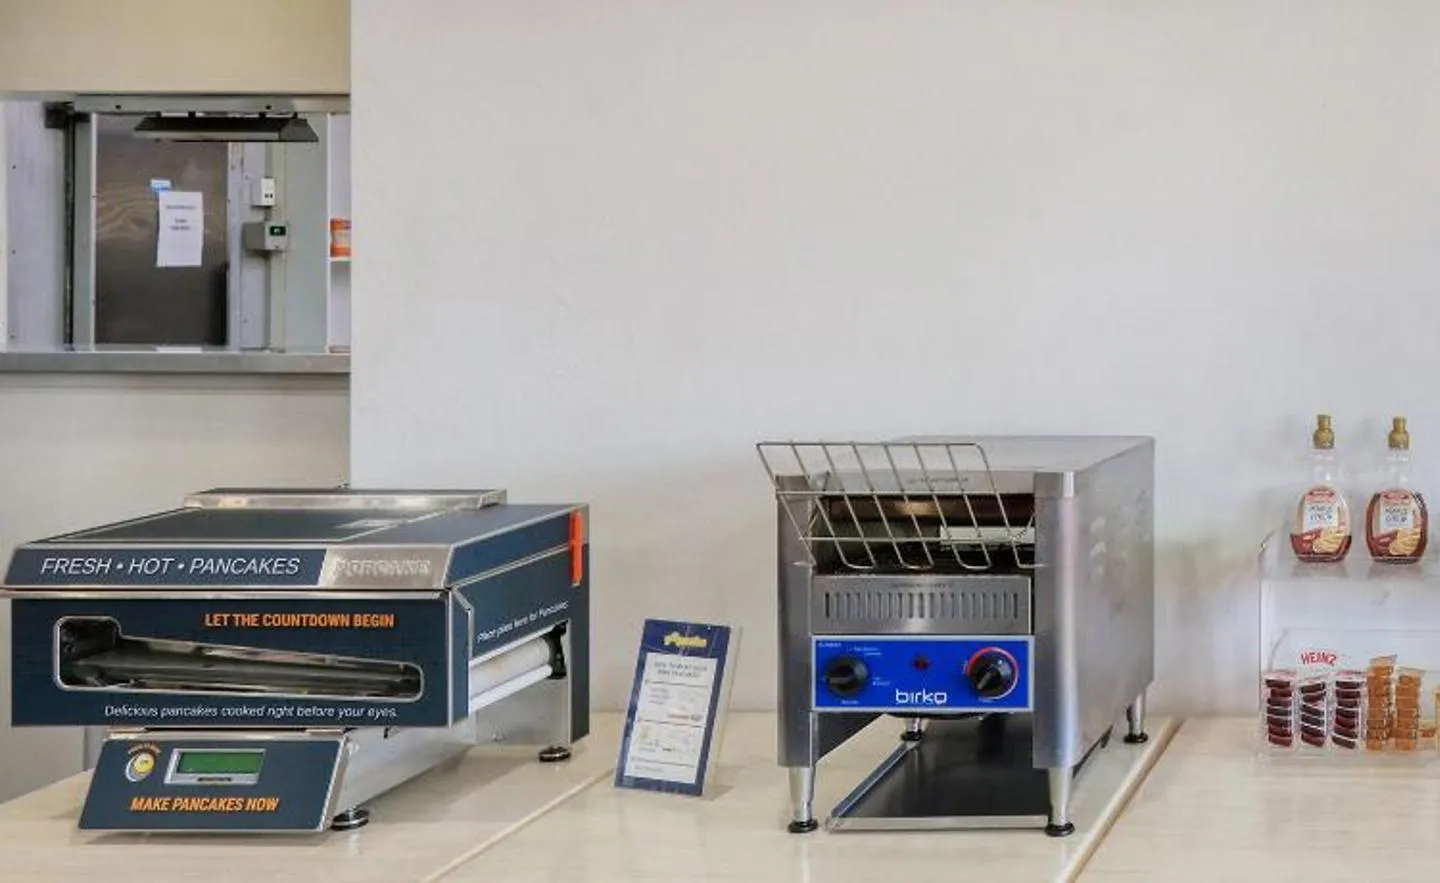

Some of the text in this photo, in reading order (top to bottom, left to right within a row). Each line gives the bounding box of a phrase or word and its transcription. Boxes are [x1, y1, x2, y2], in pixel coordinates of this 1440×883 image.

[40, 557, 301, 575] FRESH HOT PANCAKES
[205, 612, 395, 628] LET THE COUNTDOWN BEGIN
[895, 688, 948, 705] birko
[104, 703, 159, 718] Delicious
[160, 704, 218, 719] pancakes
[221, 704, 265, 718] cooked
[267, 704, 294, 720] right
[296, 704, 335, 718] before
[338, 707, 364, 721] your
[130, 796, 280, 812] MAKE PANCAKES NOW
